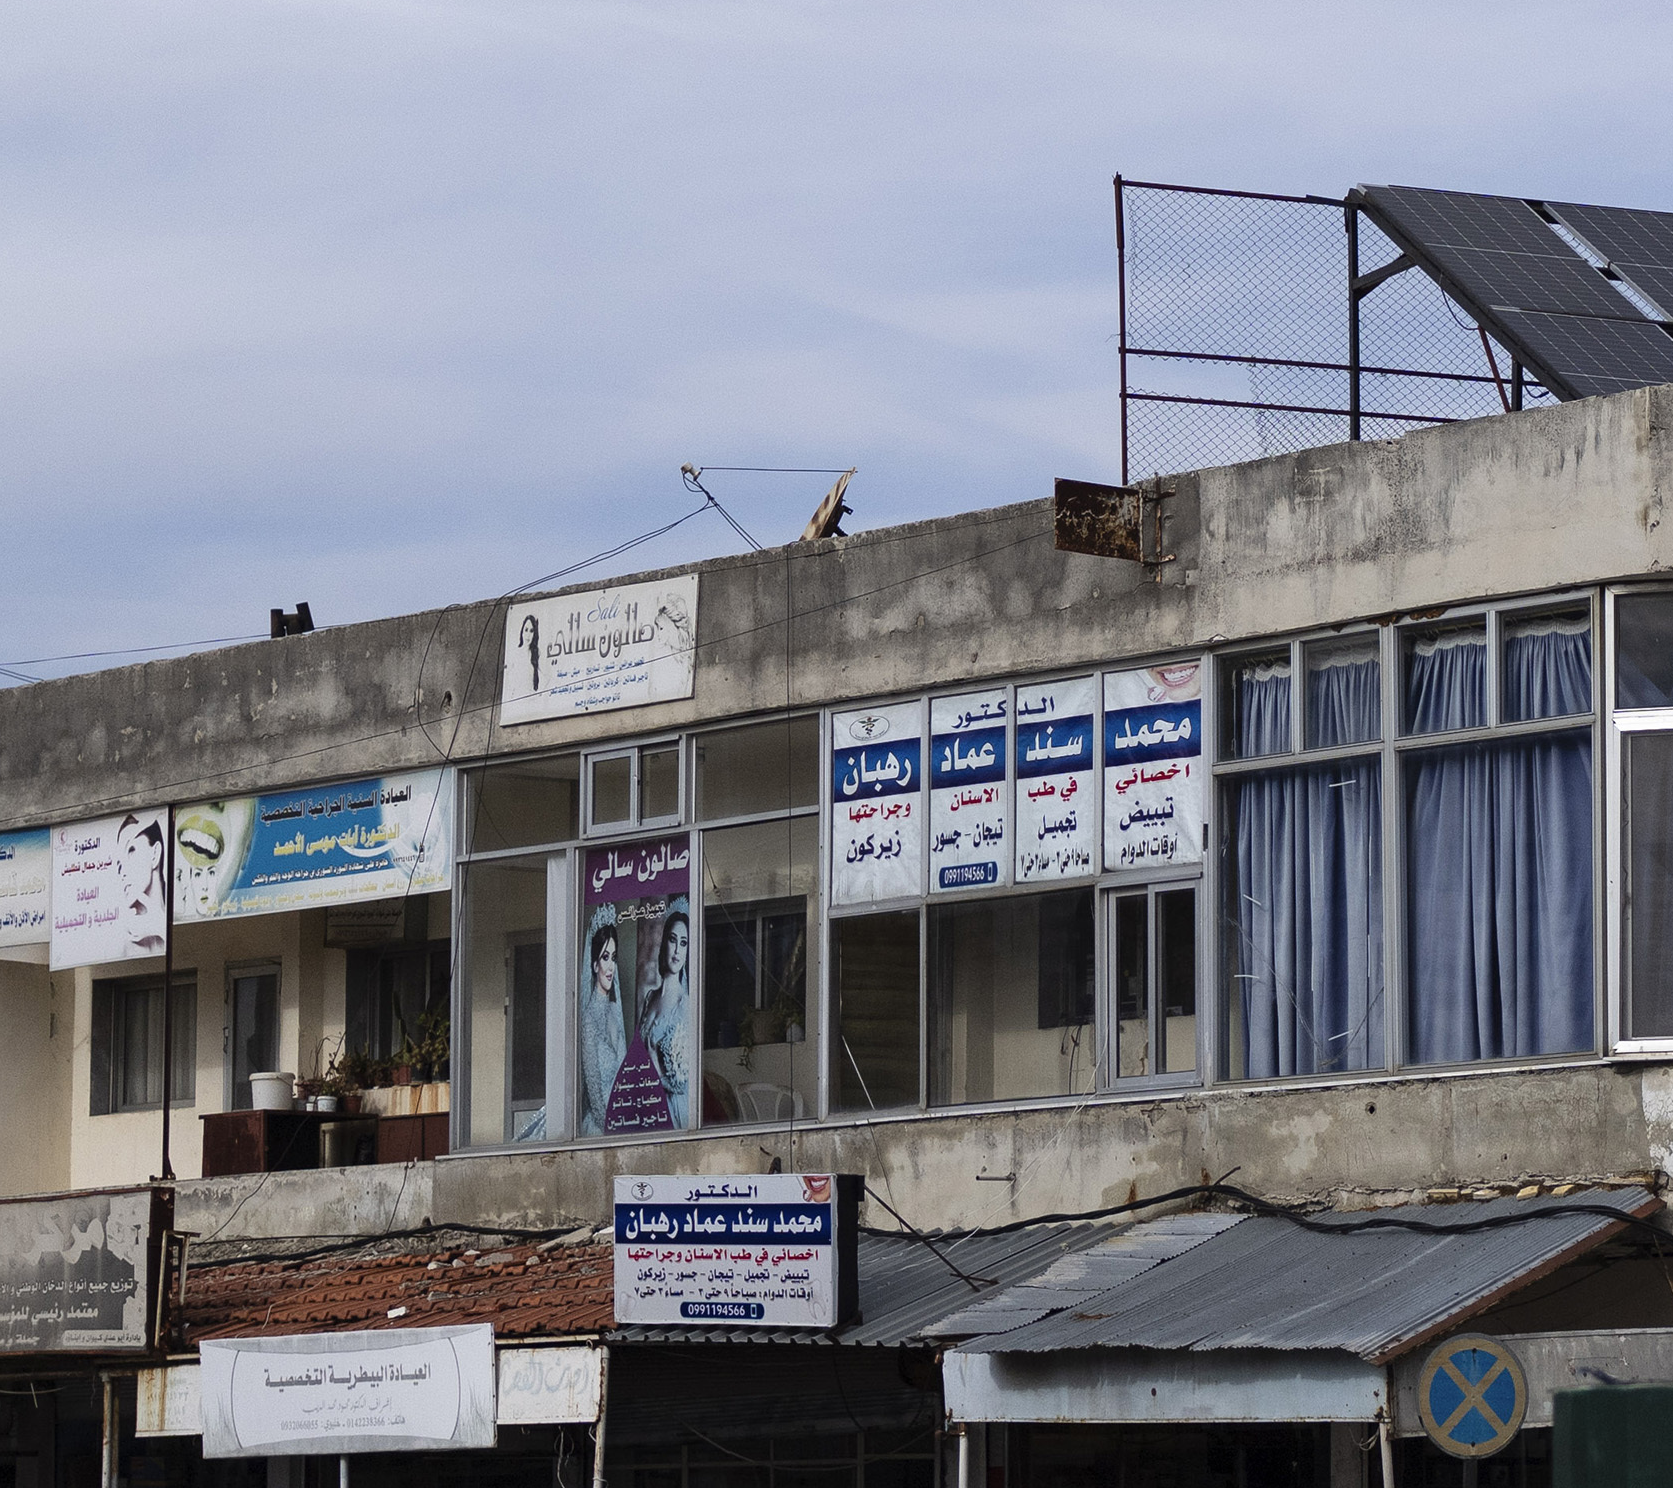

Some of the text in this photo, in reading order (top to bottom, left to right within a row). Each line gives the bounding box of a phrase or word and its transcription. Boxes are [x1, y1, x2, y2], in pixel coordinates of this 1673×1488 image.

[587, 594, 620, 622] Sali
[843, 717, 1192, 795] محمد سند عماد رهبان
[849, 763, 1190, 823] اخصائي في طب الاسنان وجراحتها
[846, 797, 1174, 863] تبييض تجميل تيجان جسور زيركون
[75, 837, 100, 855] الدكتورة
[592, 843, 689, 892] صالون سالي
[944, 866, 985, 884] 0991194566
[77, 886, 99, 902] العيادة
[684, 1184, 758, 1201] الدكتور
[626, 1208, 822, 1240] محمد سند عماد رهبان
[627, 1248, 819, 1266] اخصائي في طب الاسنان وجراحتها
[637, 1268, 809, 1283] تبييض تجميل تيجان جسور زيركون
[688, 1305, 745, 1316] 0991194566
[17, 1333, 40, 1346] جملة
[265, 1362, 431, 1392] العيادة البيطرية التخصصية
